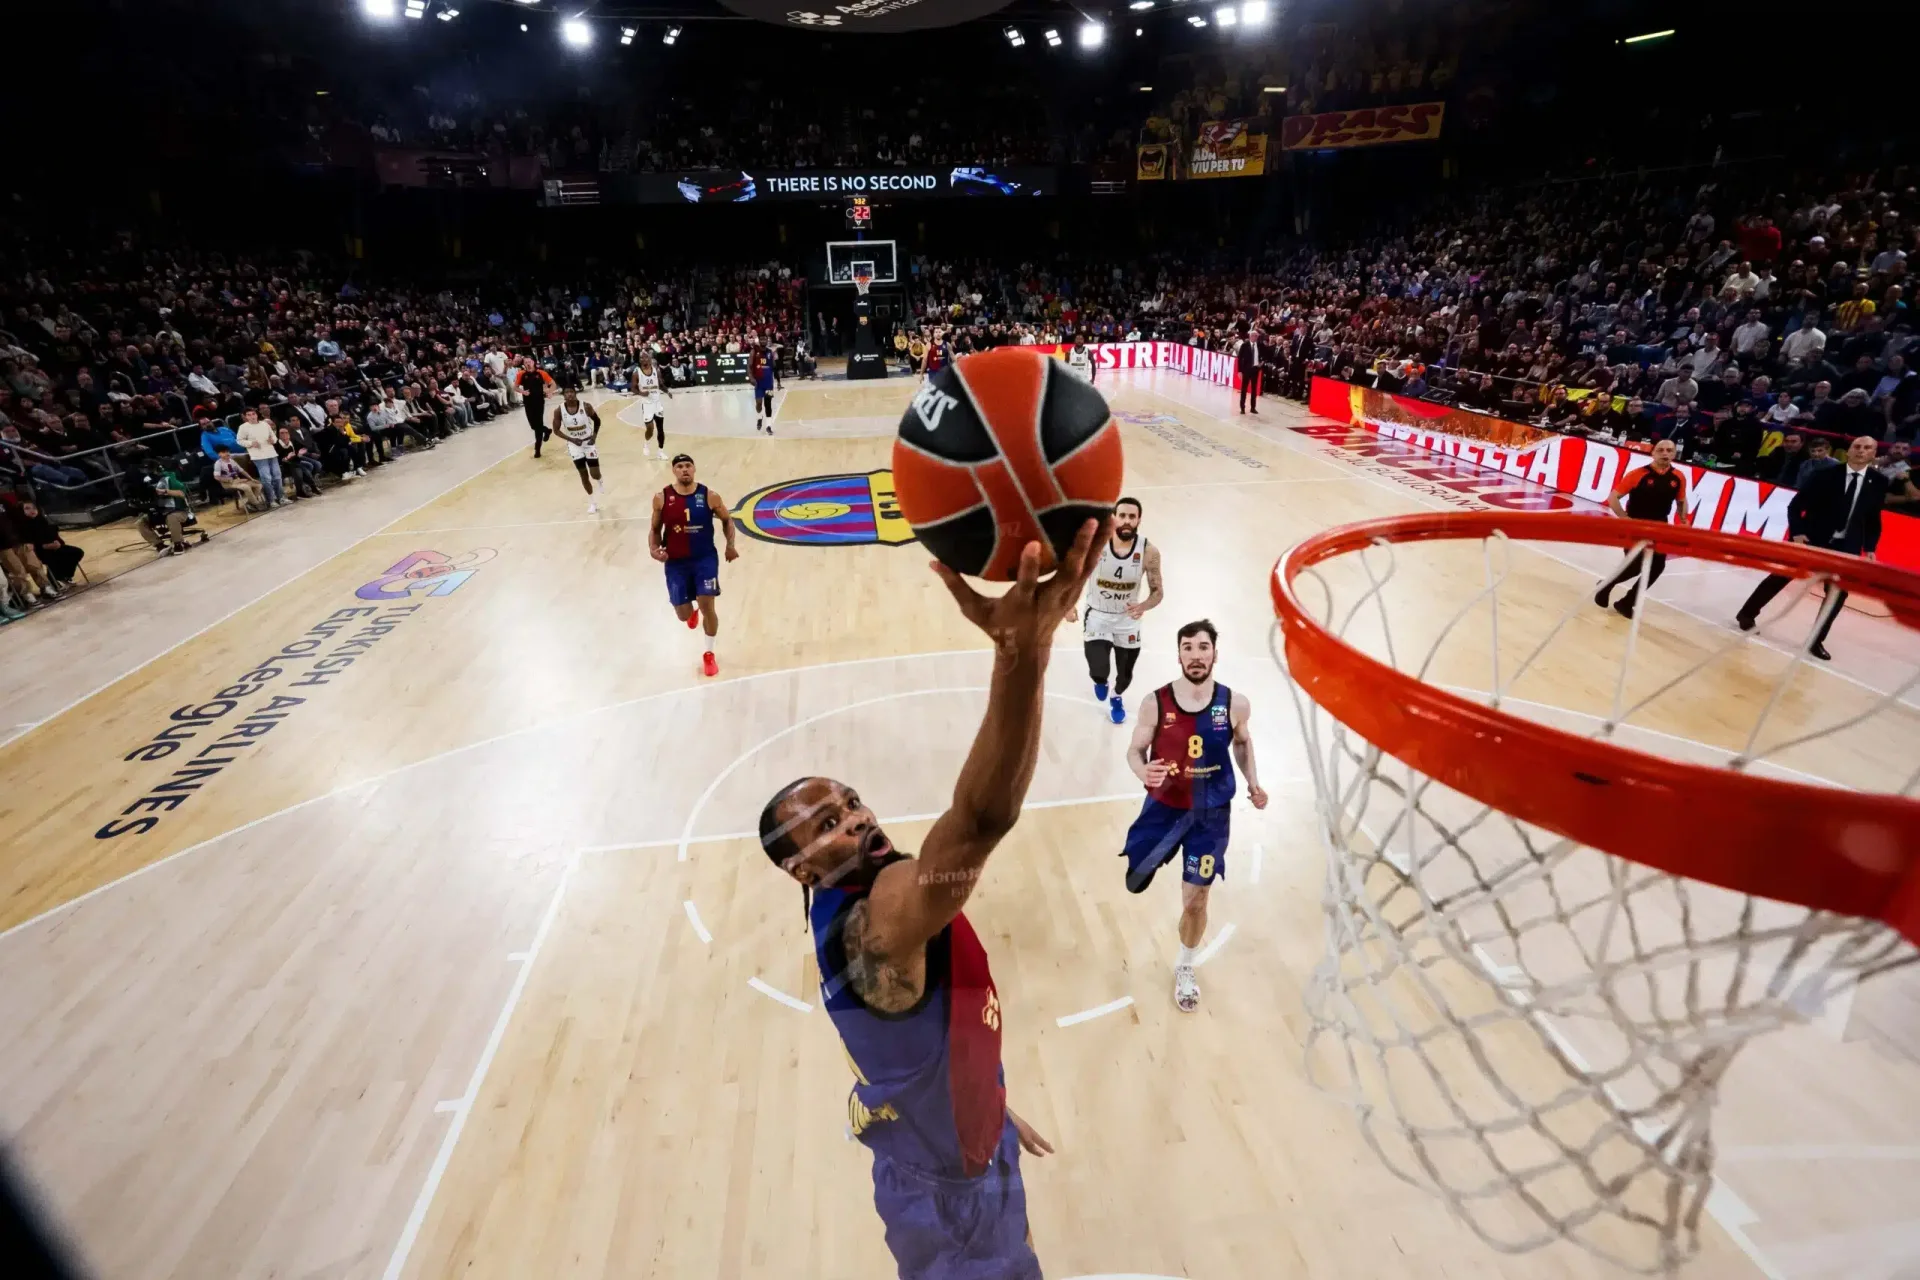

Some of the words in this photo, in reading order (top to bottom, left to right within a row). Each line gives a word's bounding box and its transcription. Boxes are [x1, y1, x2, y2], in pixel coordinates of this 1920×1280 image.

[1210, 159, 1229, 172] PER
[1231, 158, 1245, 170] TU
[766, 177, 820, 193] THERE
[823, 176, 837, 191] IS
[841, 175, 867, 191] NO
[869, 175, 937, 190] SECOND
[1191, 347, 1236, 388] DAMM
[572, 417, 578, 426] 3
[1289, 425, 1612, 517] BARCELO
[1571, 434, 1798, 542] DMM
[684, 507, 691, 522] 1
[1114, 566, 1123, 580] 4
[288, 603, 423, 687] TURKISH
[124, 606, 379, 762] EuroLeague
[1187, 735, 1204, 759] 8
[94, 695, 307, 840] AIRLINES
[1198, 854, 1215, 879] 8
